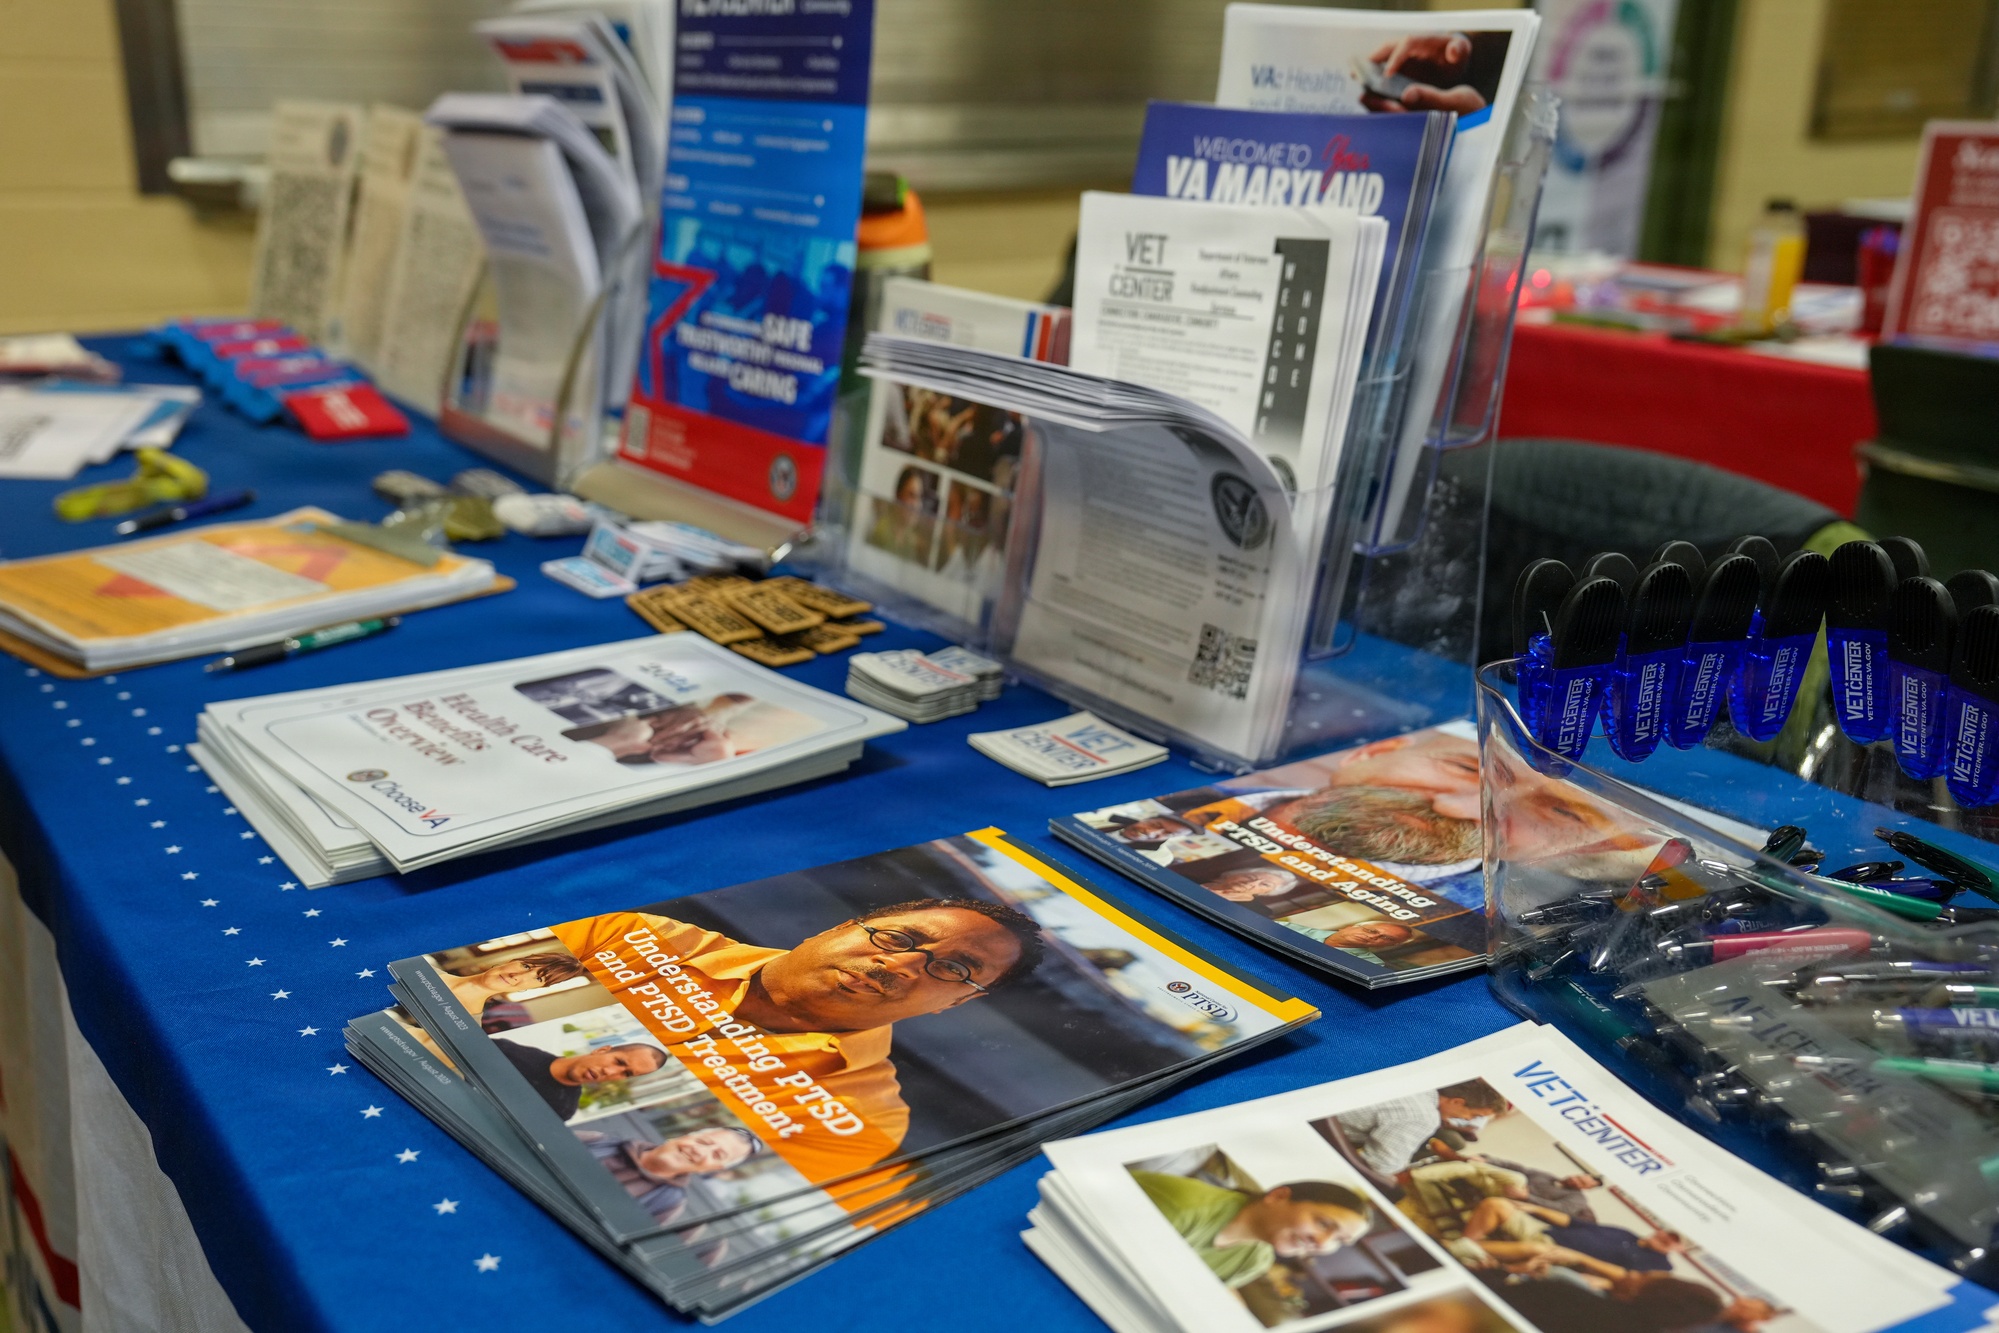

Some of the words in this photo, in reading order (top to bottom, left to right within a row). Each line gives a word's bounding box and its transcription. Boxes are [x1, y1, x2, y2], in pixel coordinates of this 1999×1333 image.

[1286, 67, 1347, 94] Health
[1166, 154, 1209, 199] VA
[1210, 162, 1385, 216] MARYLAND
[1193, 135, 1285, 167] WELCOME
[1286, 144, 1313, 168] TO
[1124, 231, 1169, 266] VET
[1109, 273, 1175, 303] CENTER
[762, 312, 814, 352] SAFE
[1290, 289, 1313, 388] HOME
[728, 363, 798, 405] CARING
[1575, 677, 1594, 753] VETCENTER.VA.GOV
[1652, 662, 1666, 739] VETCENTER.VA.GOV
[1701, 653, 1725, 728] VETCENTER.VA.GOV
[1778, 647, 1799, 719] VETCENTER.VA.GOV
[1865, 642, 1875, 722] VETCENTER.VA.GOV
[366, 707, 466, 766] Overview
[403, 699, 492, 752] Benefits
[440, 691, 515, 738] Health
[508, 733, 568, 765] Care
[1010, 728, 1100, 772] CENTER
[1066, 723, 1135, 755] VET
[1920, 681, 1928, 759] VETCENTER.VA.GOV
[1972, 711, 1989, 788] VETCENTER.VA.GOV
[1213, 819, 1286, 856] PTSD
[1279, 852, 1339, 882] and
[1330, 880, 1421, 922] Aging
[1248, 816, 1438, 909] Understanding
[443, 1004, 460, 1025] August
[623, 926, 788, 1073] Understanding
[774, 1069, 865, 1137] PTSD
[1181, 992, 1229, 1019] PTSD
[594, 948, 647, 984] and
[627, 981, 697, 1034] PTSD
[682, 1033, 807, 1139] Treatment
